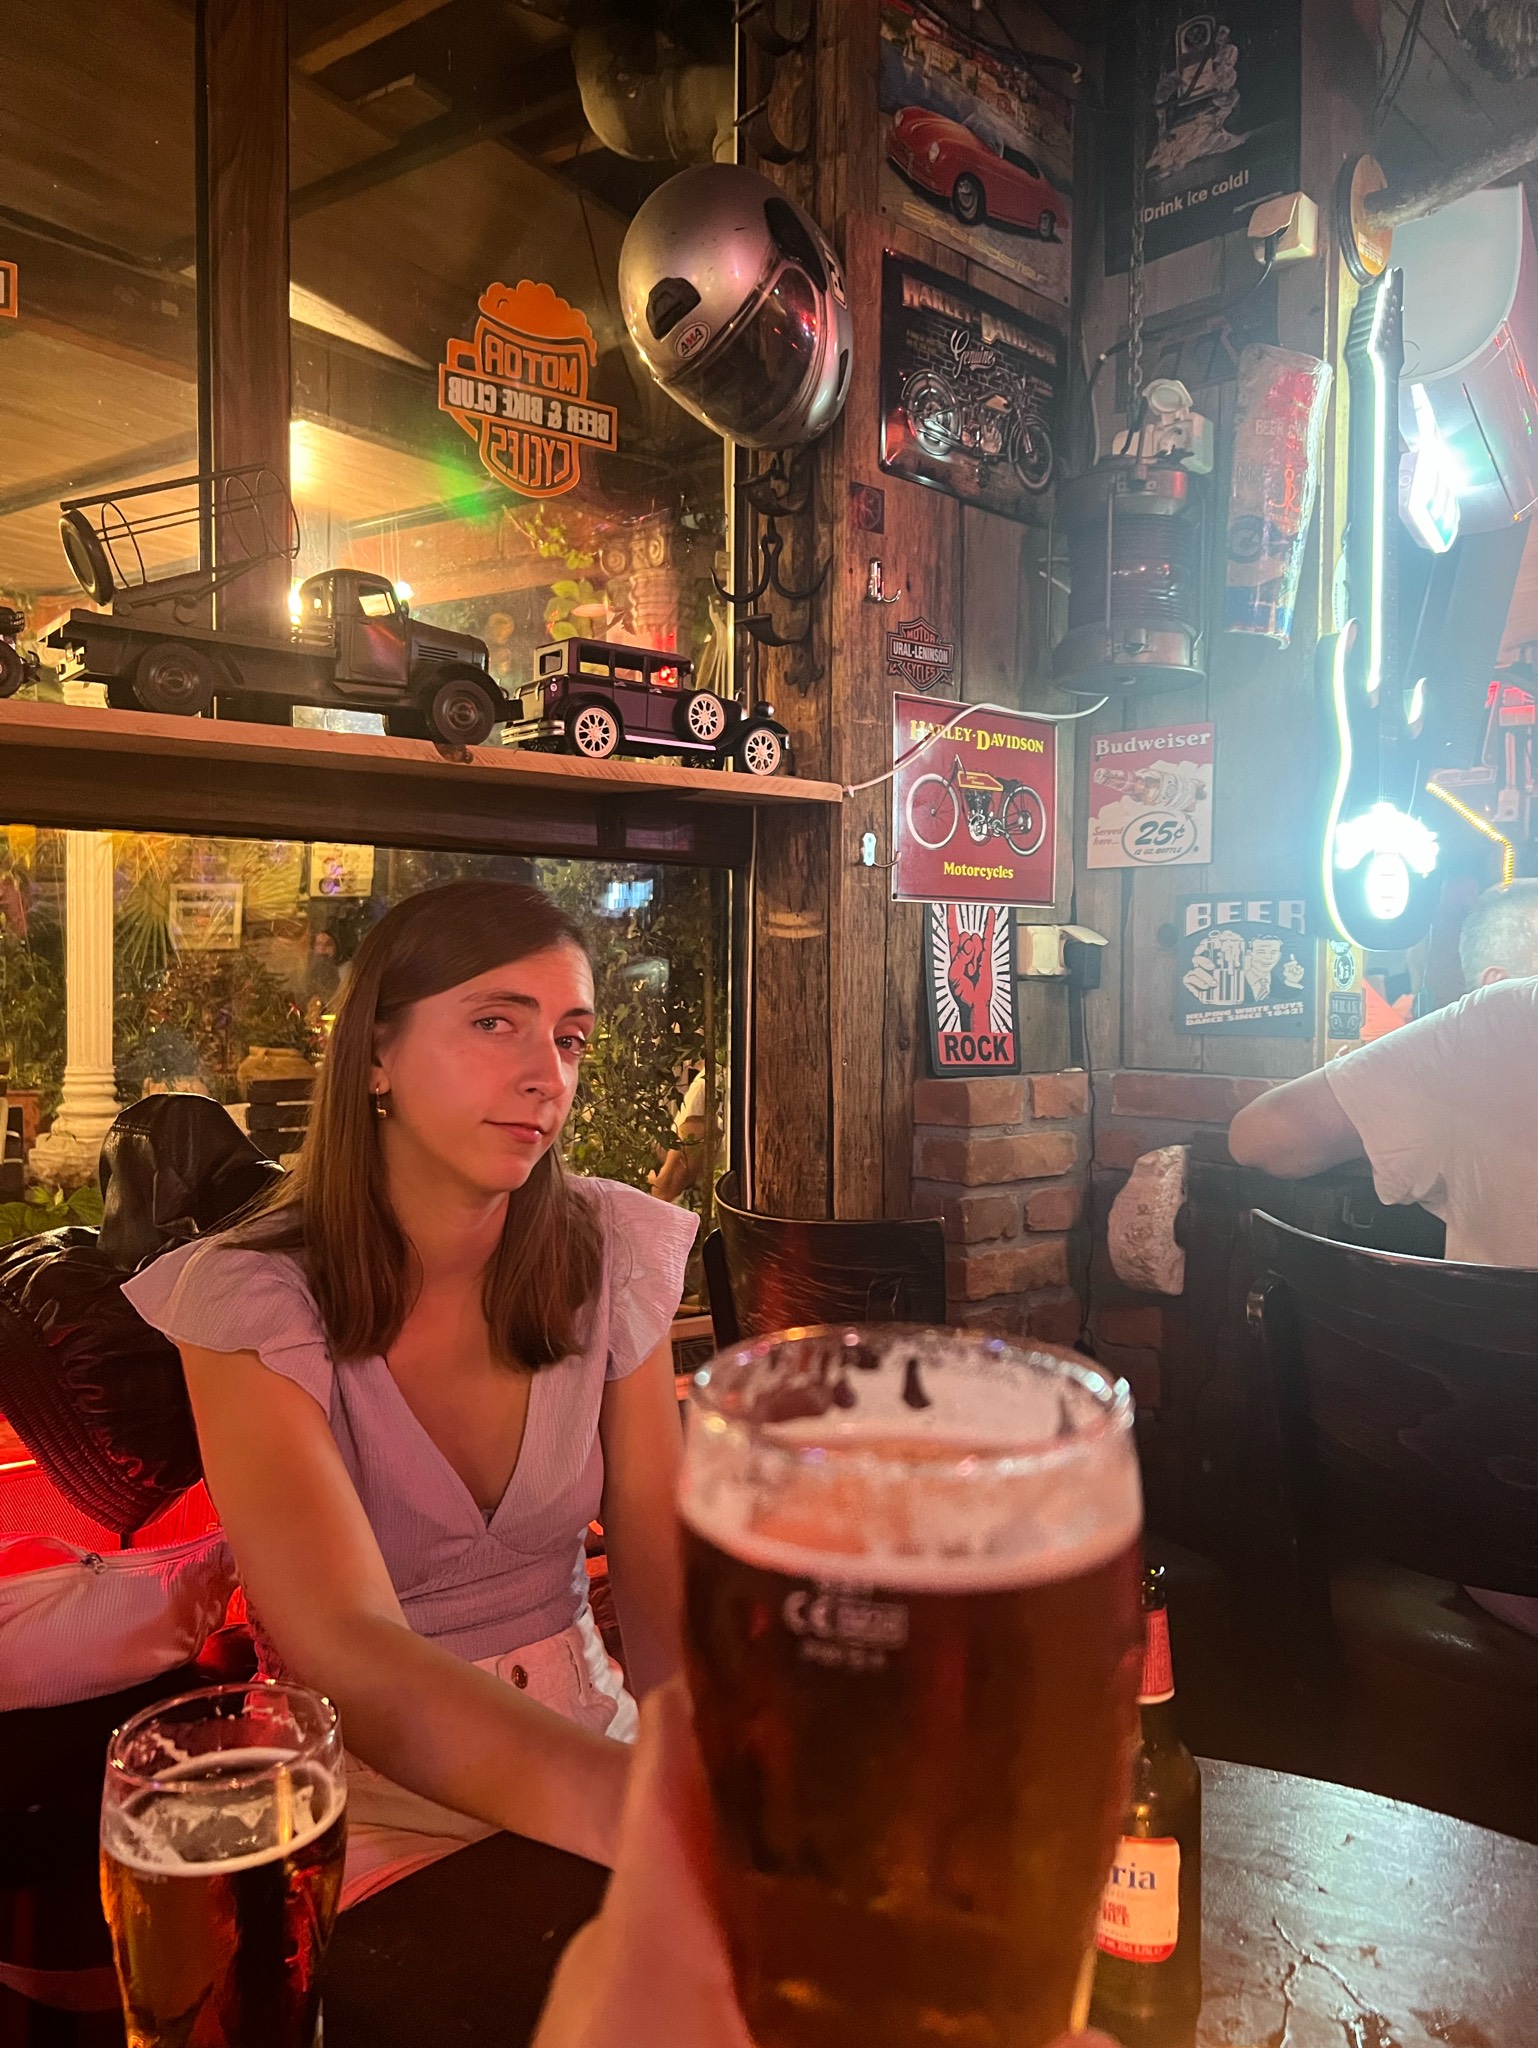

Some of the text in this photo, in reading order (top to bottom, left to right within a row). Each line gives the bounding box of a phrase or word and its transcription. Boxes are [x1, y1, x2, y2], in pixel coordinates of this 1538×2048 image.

[1187, 190, 1208, 207] ice
[1211, 169, 1249, 197] cold!
[906, 626, 936, 643] MOTOR
[907, 662, 936, 683] CYCLES
[1095, 732, 1211, 756] Budweiser
[1134, 820, 1185, 845] 25¢
[943, 861, 1014, 881] Motorcycles
[1184, 899, 1306, 937] BEER
[1185, 1001, 1304, 1020] HELPING WHITE GUYS
[1227, 1012, 1262, 1022] SINCE
[943, 1034, 1010, 1062] ROCK
